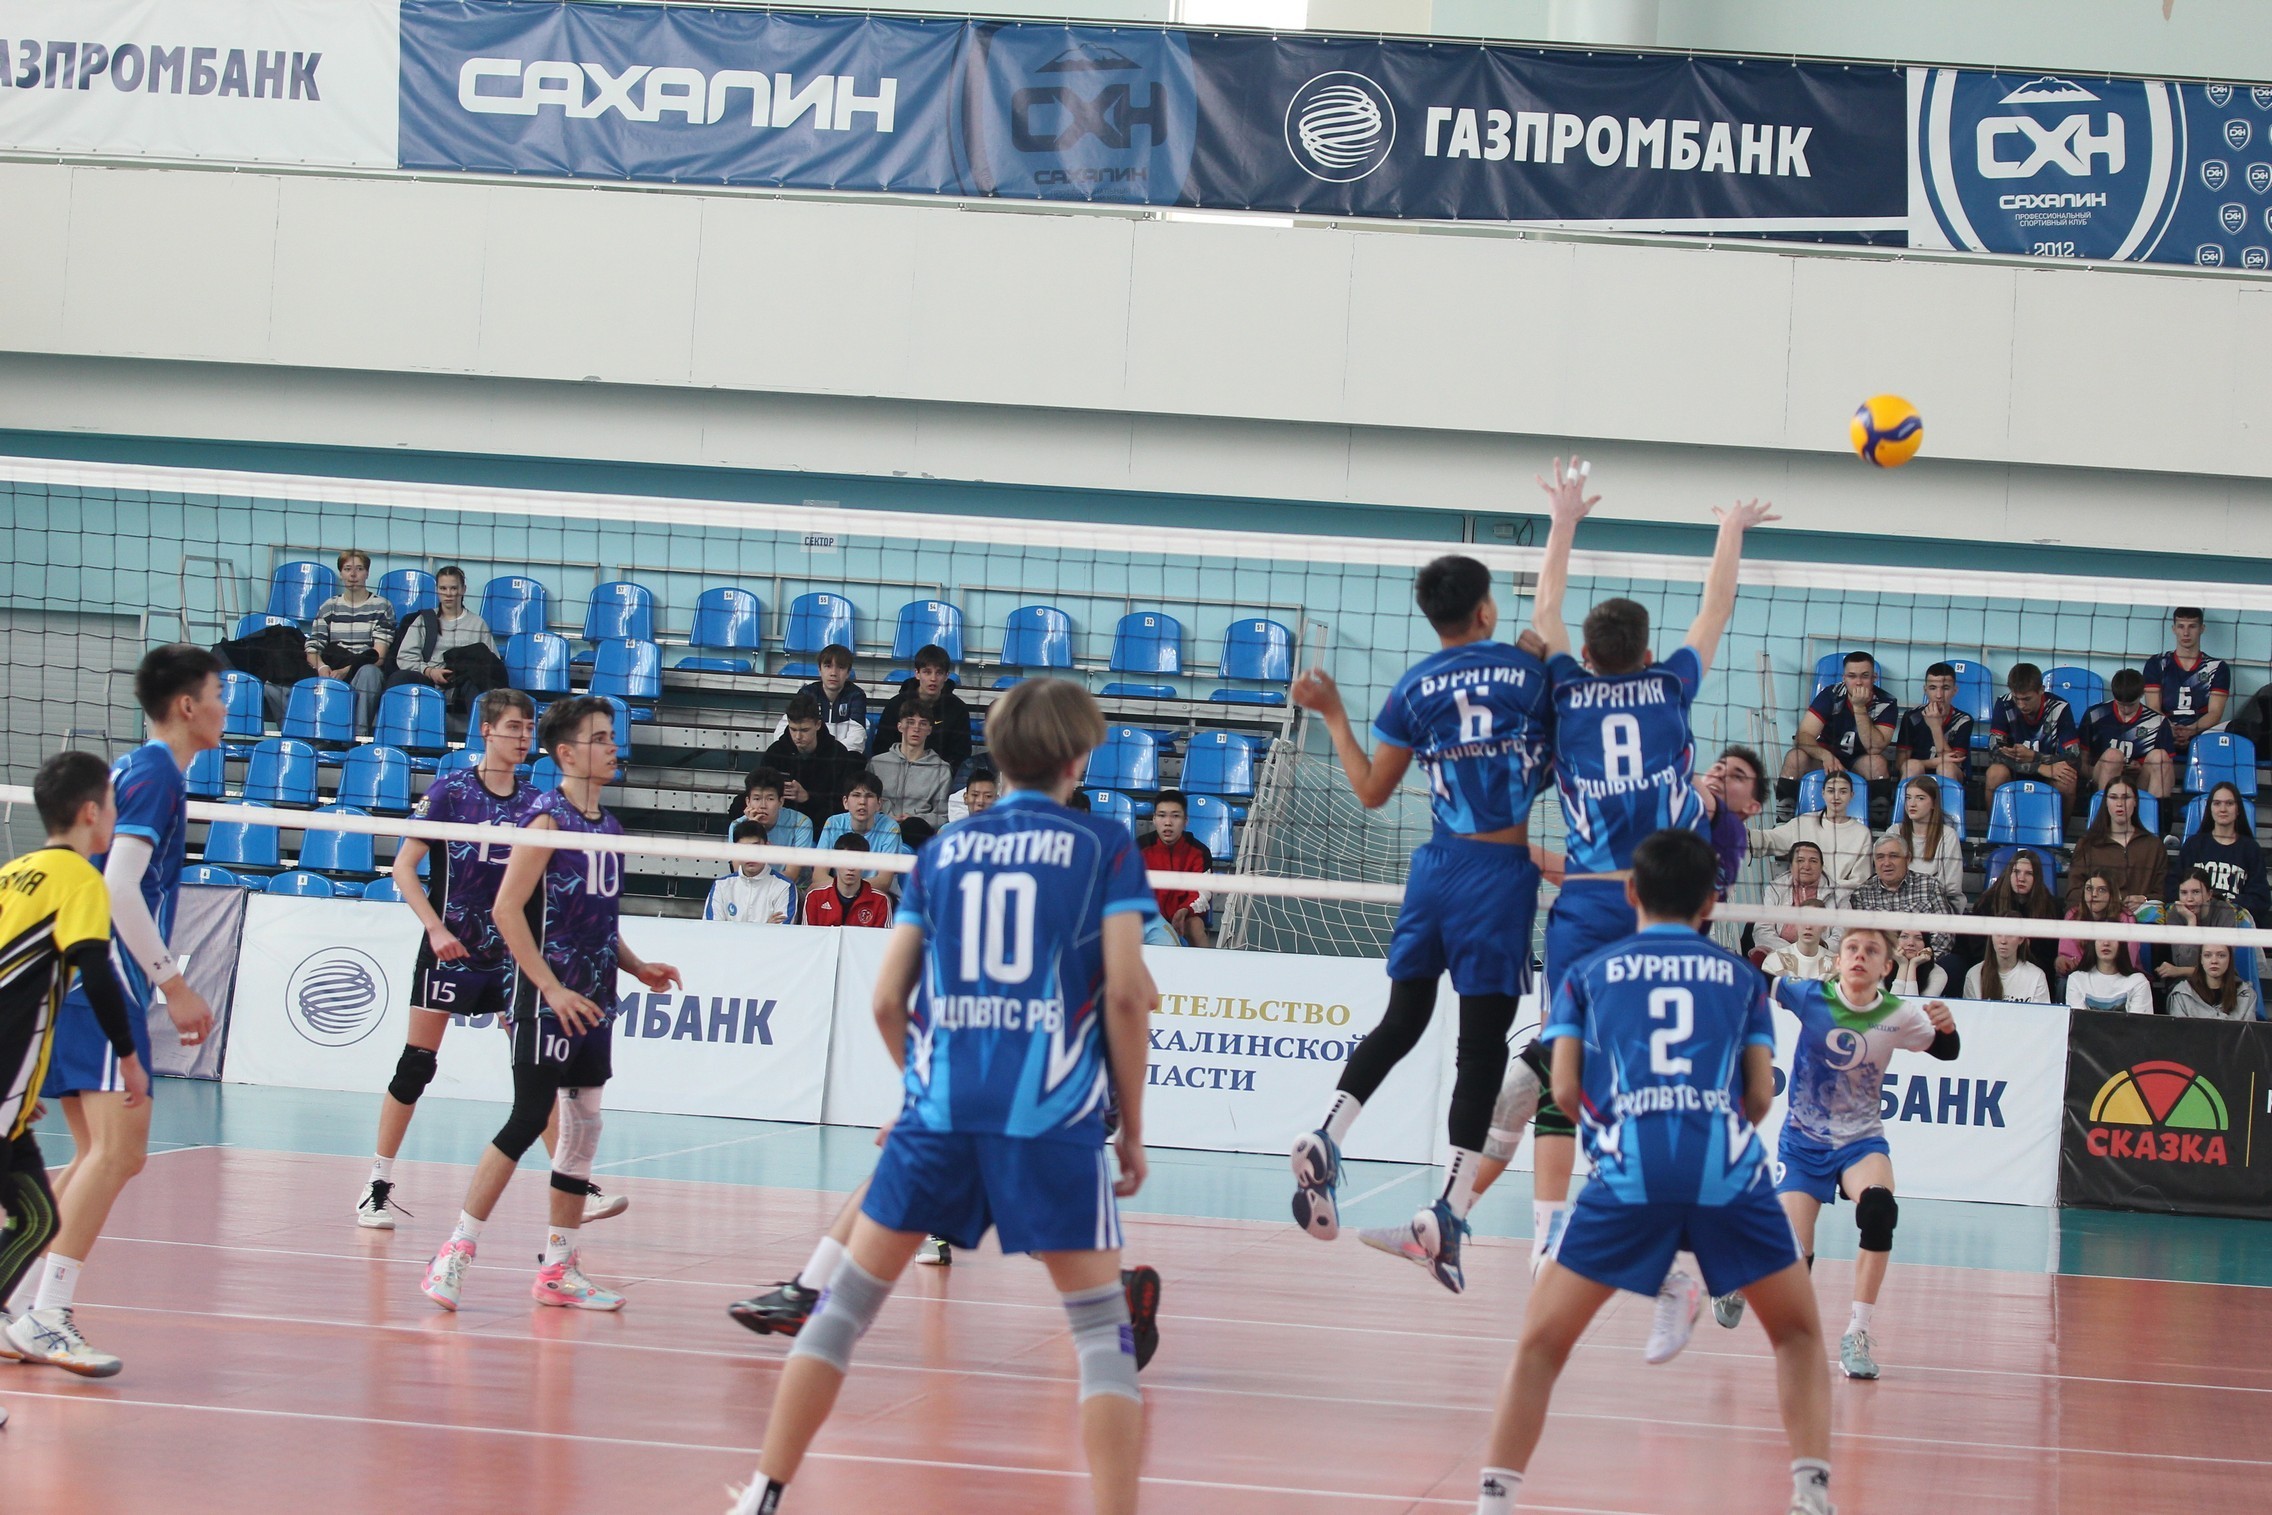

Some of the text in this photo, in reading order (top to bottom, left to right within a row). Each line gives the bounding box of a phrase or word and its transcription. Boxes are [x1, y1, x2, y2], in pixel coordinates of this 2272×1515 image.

[458, 57, 898, 133] САХАЛИН
[1424, 106, 1813, 178] ГАЗПРОМБАНК
[1999, 192, 2107, 209] САХАЛИН
[2015, 211, 2092, 220] ПРОФЕССИОНАЛЬНЫЙ
[2019, 218, 2088, 227] СПОРТИВНЫЙ КЛУБ
[2034, 241, 2075, 258] 2012
[804, 536, 834, 547] СЕКТОР
[1570, 677, 1666, 709] БУРЯТИЯ
[2177, 686, 2192, 710] 6
[1601, 713, 1643, 782] 8
[1840, 731, 1856, 755] 9
[936, 829, 1076, 869] БУРЯТИЯ
[958, 870, 1038, 984] 10
[1605, 953, 1734, 987] БУРЯТИЯ
[431, 980, 457, 1003] 15
[617, 991, 778, 1045] МБАНК
[1152, 993, 1350, 1026] ТЕЛЬСТВО
[1148, 1028, 1366, 1062] ХАЛИНСКО
[1648, 986, 1694, 1076] 2
[545, 1034, 570, 1063] 10
[1825, 1026, 1868, 1072] 9
[1147, 1064, 1257, 1091] АСТИ
[1880, 1073, 2008, 1128] БАНК
[2086, 1127, 2228, 1166] СКАЗКА
